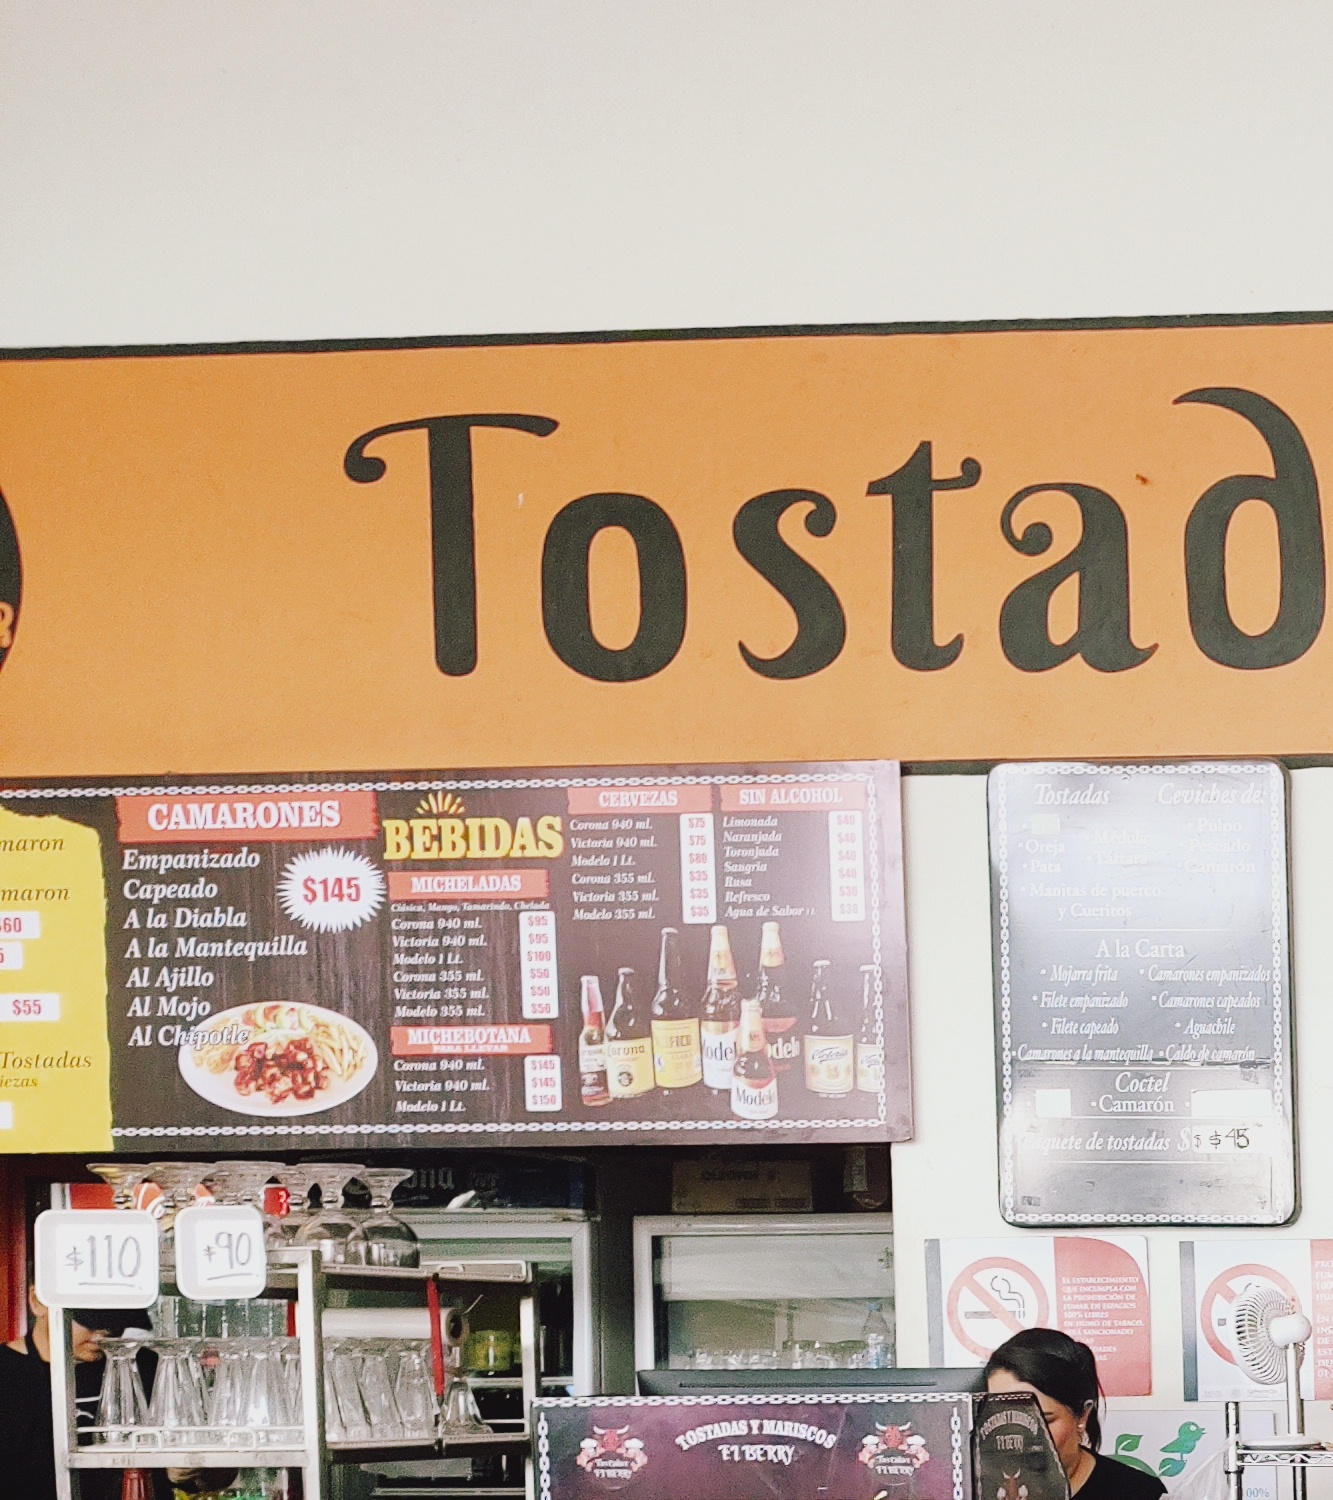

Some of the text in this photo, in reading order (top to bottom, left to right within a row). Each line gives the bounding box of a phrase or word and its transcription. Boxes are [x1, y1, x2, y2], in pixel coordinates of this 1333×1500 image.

[599, 790, 678, 807] CERVEZAS
[739, 788, 843, 804] SIN ALCOHOL
[1034, 782, 1111, 805] Tostadas
[148, 800, 341, 830] CAMARONES
[1197, 818, 1243, 833] Pulpo
[382, 815, 564, 860] BEBIDAS
[723, 831, 782, 844] Naranjada
[1025, 839, 1066, 855] Oreja
[122, 847, 261, 874] Empanizado
[724, 846, 779, 858] Toronjada
[123, 877, 218, 904] Capeado
[303, 876, 361, 905] $145
[411, 875, 521, 893] MICHELADAS
[1029, 883, 1161, 900] Manitas de puerco
[725, 891, 770, 904] Refresco
[123, 906, 247, 930] A la Diabla
[725, 906, 753, 919] Agua
[756, 906, 770, 916] de
[772, 905, 804, 916] Sabor
[1070, 903, 1131, 917] Cueritos
[392, 919, 434, 930] Corona
[438, 918, 461, 929] 940
[528, 916, 547, 926] $95
[124, 935, 308, 961] A la Mantequilla
[393, 936, 439, 947] Victoria
[442, 936, 465, 947] 940
[529, 934, 548, 944] $95
[1096, 940, 1185, 958] A la Carta
[126, 966, 214, 992] Al Ajillo
[393, 971, 436, 982] Corona
[439, 971, 462, 981] 355
[1050, 964, 1118, 986] Mojarra frita
[1148, 965, 1270, 986] Camarones empanizados
[12, 999, 42, 1016] $55
[127, 997, 211, 1021] Al Mojo
[1040, 991, 1128, 1012] Filete empanizado
[1159, 992, 1260, 1012] Camarones capeados
[128, 1025, 250, 1049] Al Chipotle
[407, 1028, 531, 1045] MICHEBOTANA
[1051, 1018, 1118, 1039] Filete capeado
[1183, 1018, 1235, 1039] Aguachile
[1, 1051, 92, 1069] Tostadas
[1018, 1044, 1071, 1061] Camarones
[1082, 1046, 1092, 1060] la
[1095, 1044, 1152, 1065] mantequilla
[394, 1060, 436, 1071] Corona
[440, 1059, 463, 1070] 940
[531, 1060, 554, 1070] $145
[395, 1081, 441, 1091] Victoria
[445, 1080, 468, 1091] 940
[532, 1078, 556, 1088] $145
[1115, 1072, 1170, 1093] Coctel
[1099, 1095, 1175, 1113] Camarón
[65, 1235, 140, 1278] $110
[675, 1419, 837, 1451] TOSTADAS Y MARISCOS
